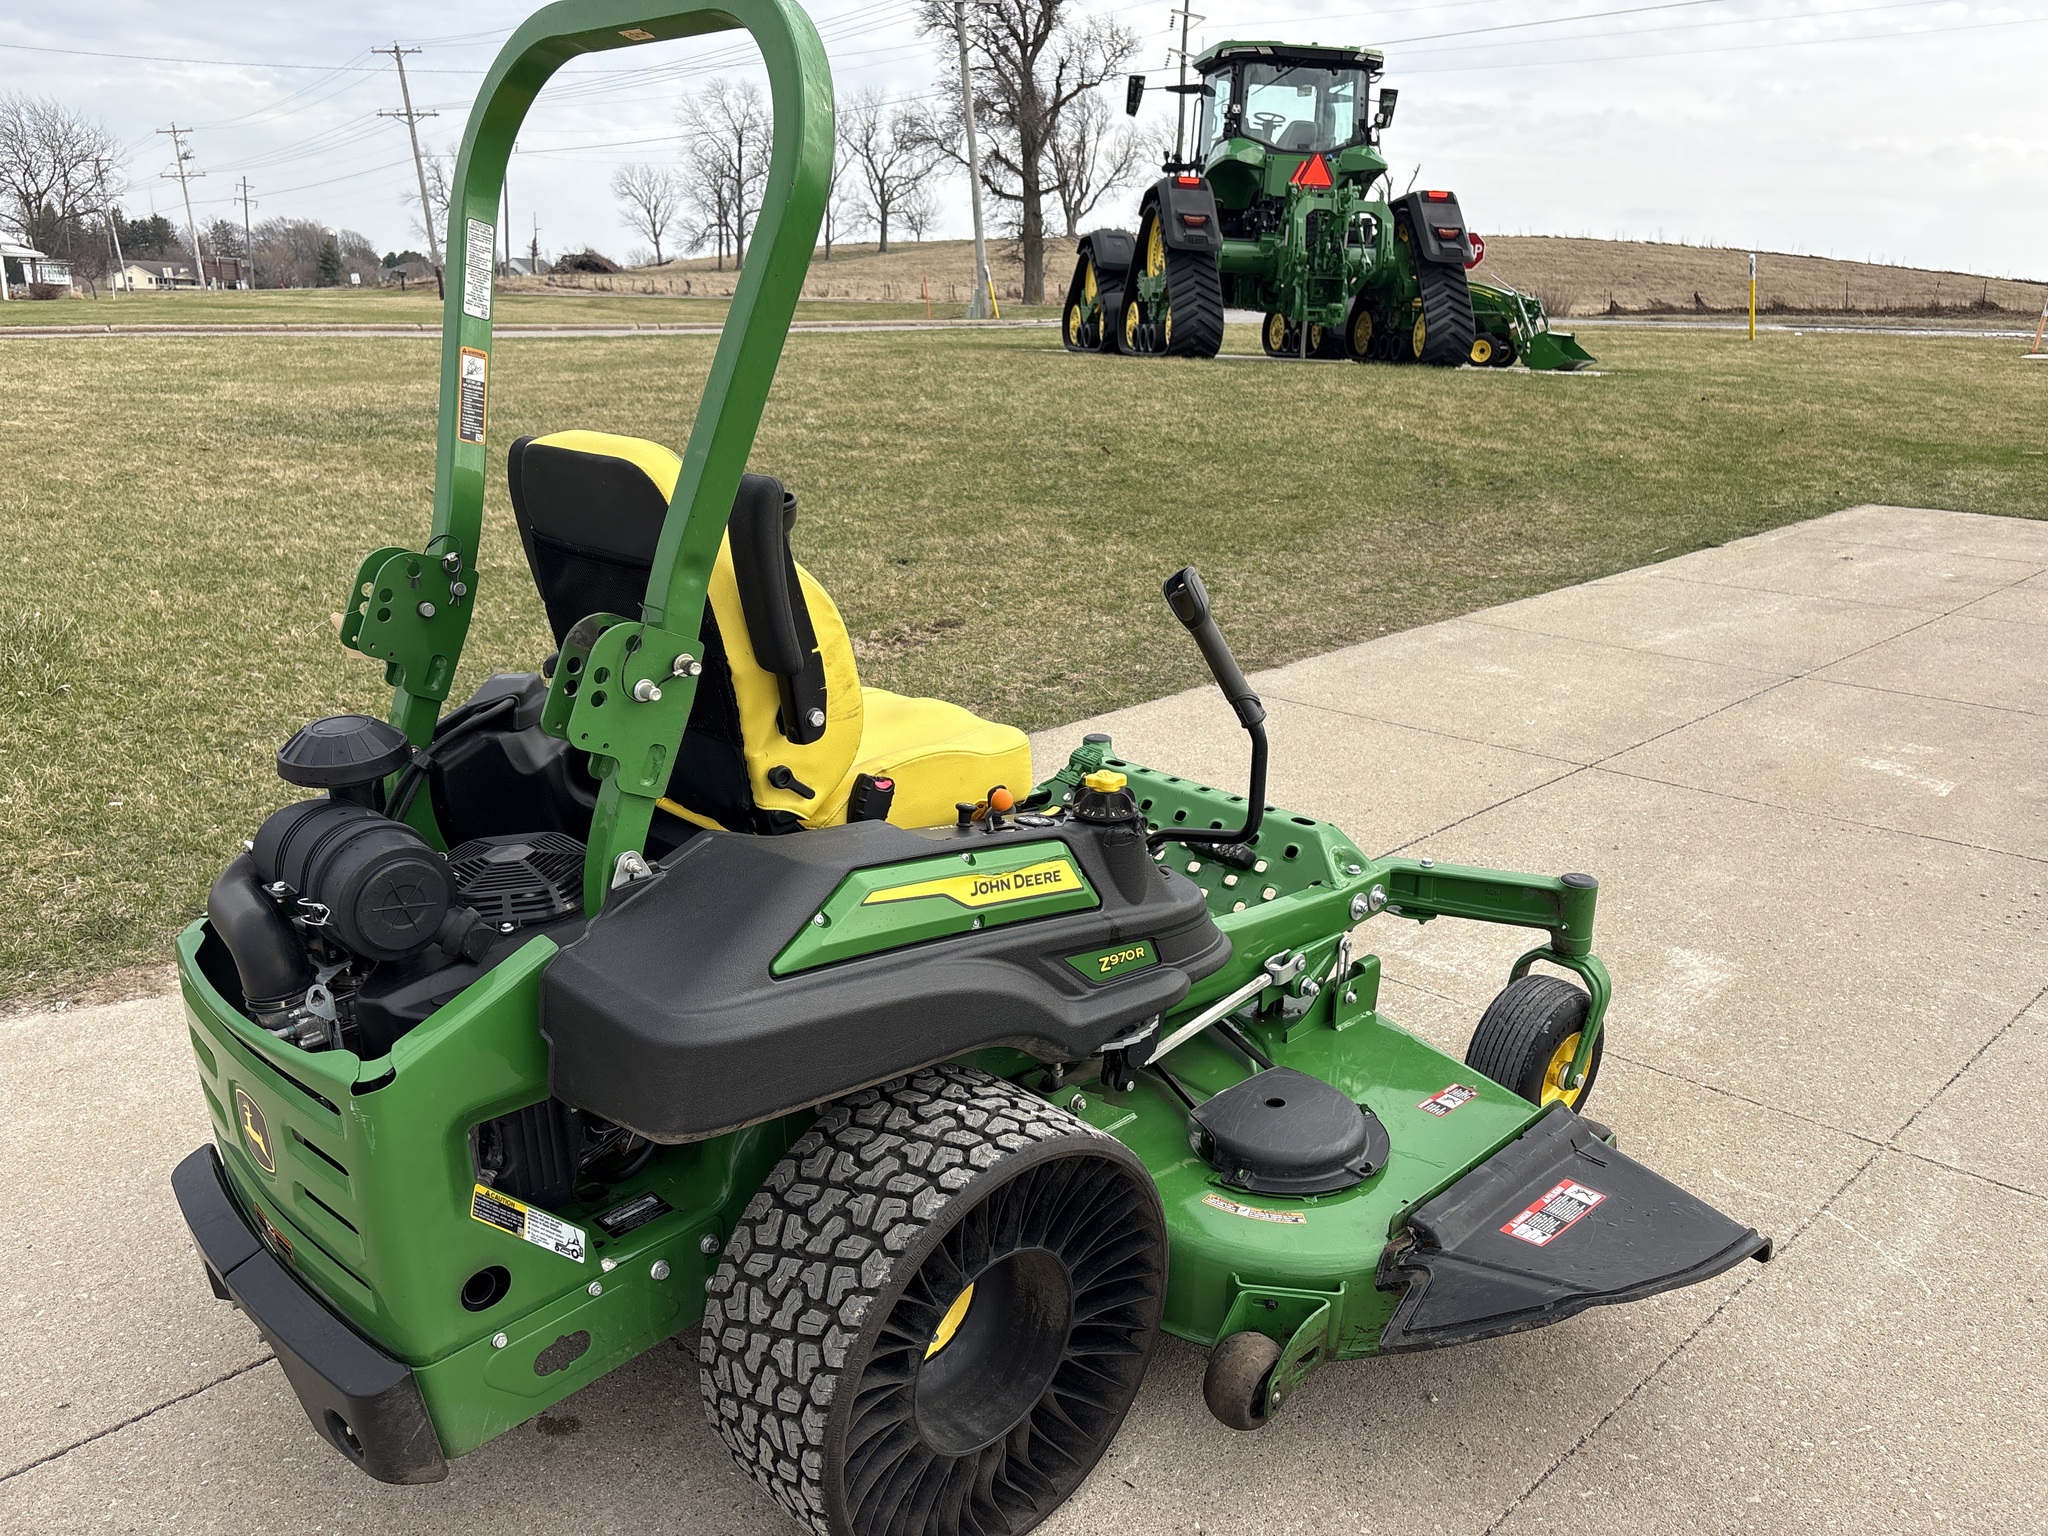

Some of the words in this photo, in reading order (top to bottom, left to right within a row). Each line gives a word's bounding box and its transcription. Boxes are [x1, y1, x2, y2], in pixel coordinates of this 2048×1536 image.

[970, 879, 1011, 897] JOHN
[1014, 870, 1062, 889] DEERE
[1098, 946, 1145, 973] Z970R
[490, 1192, 516, 1208] CAUTION
[901, 1231, 938, 1275] TWEEL
[935, 1199, 966, 1230] TURF
